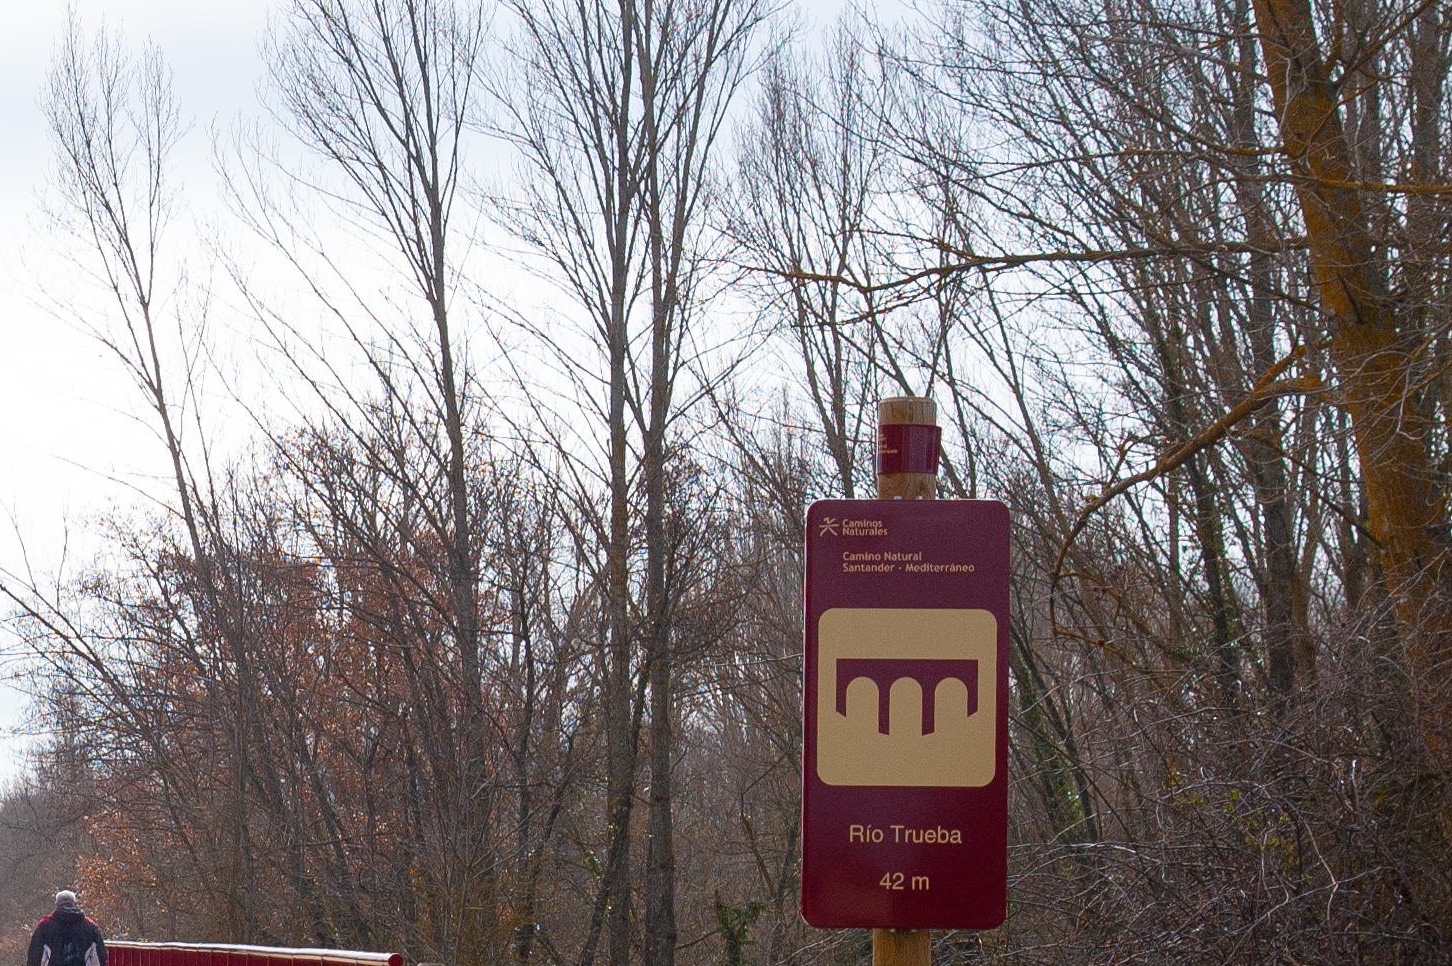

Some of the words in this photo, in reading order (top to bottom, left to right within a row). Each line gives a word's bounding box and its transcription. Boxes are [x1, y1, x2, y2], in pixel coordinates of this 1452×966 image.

[842, 519, 883, 528] Caminos
[842, 527, 888, 536] Naturales
[842, 551, 882, 561] Camino
[884, 551, 923, 561] Natural
[842, 562, 896, 573] Santander
[905, 562, 975, 573] Mediterráneo
[849, 824, 884, 844] Río
[890, 825, 963, 844] Trueba
[879, 872, 905, 890] 42
[911, 875, 930, 890] m
